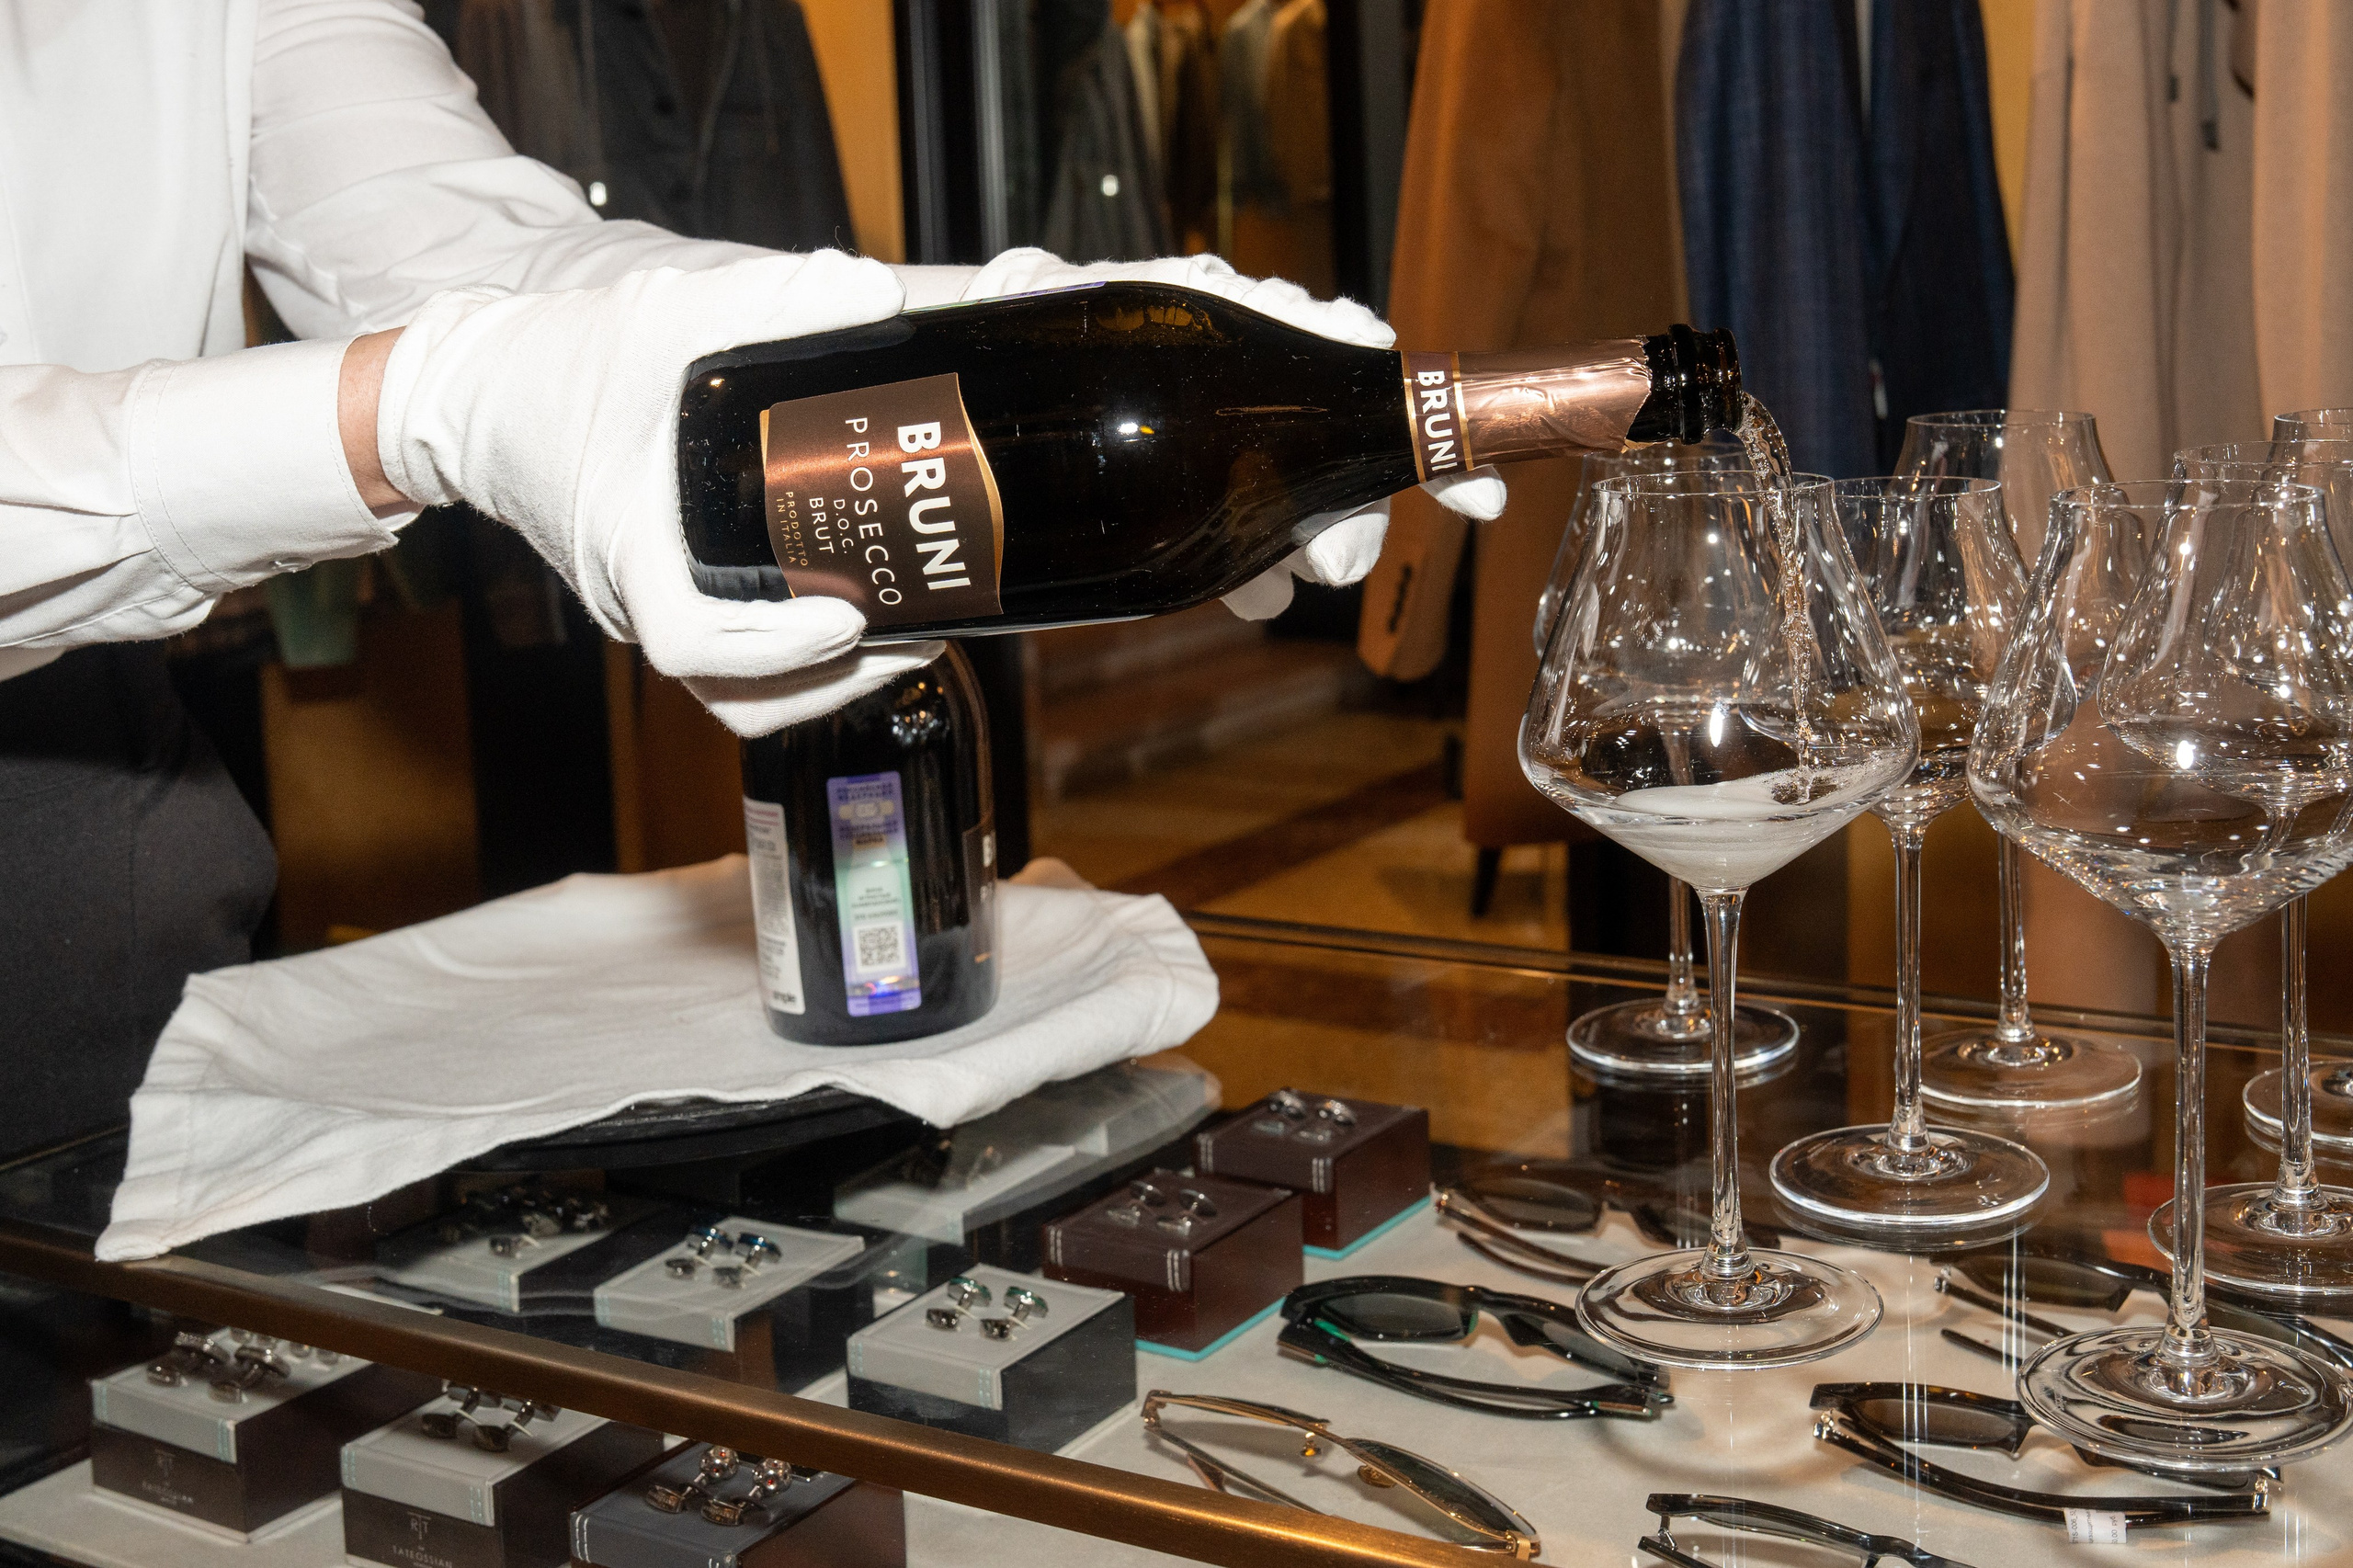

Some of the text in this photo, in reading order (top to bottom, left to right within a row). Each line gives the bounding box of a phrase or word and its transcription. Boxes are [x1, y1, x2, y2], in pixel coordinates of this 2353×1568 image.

[1417, 370, 1458, 472] BRUNI
[776, 497, 797, 563] IN ITALIA
[785, 491, 809, 566] PRODOTTO
[809, 496, 835, 554] BRUT
[833, 498, 855, 554] D.O.C.
[845, 417, 903, 606] PROSECCO
[897, 421, 972, 590] BRUNI
